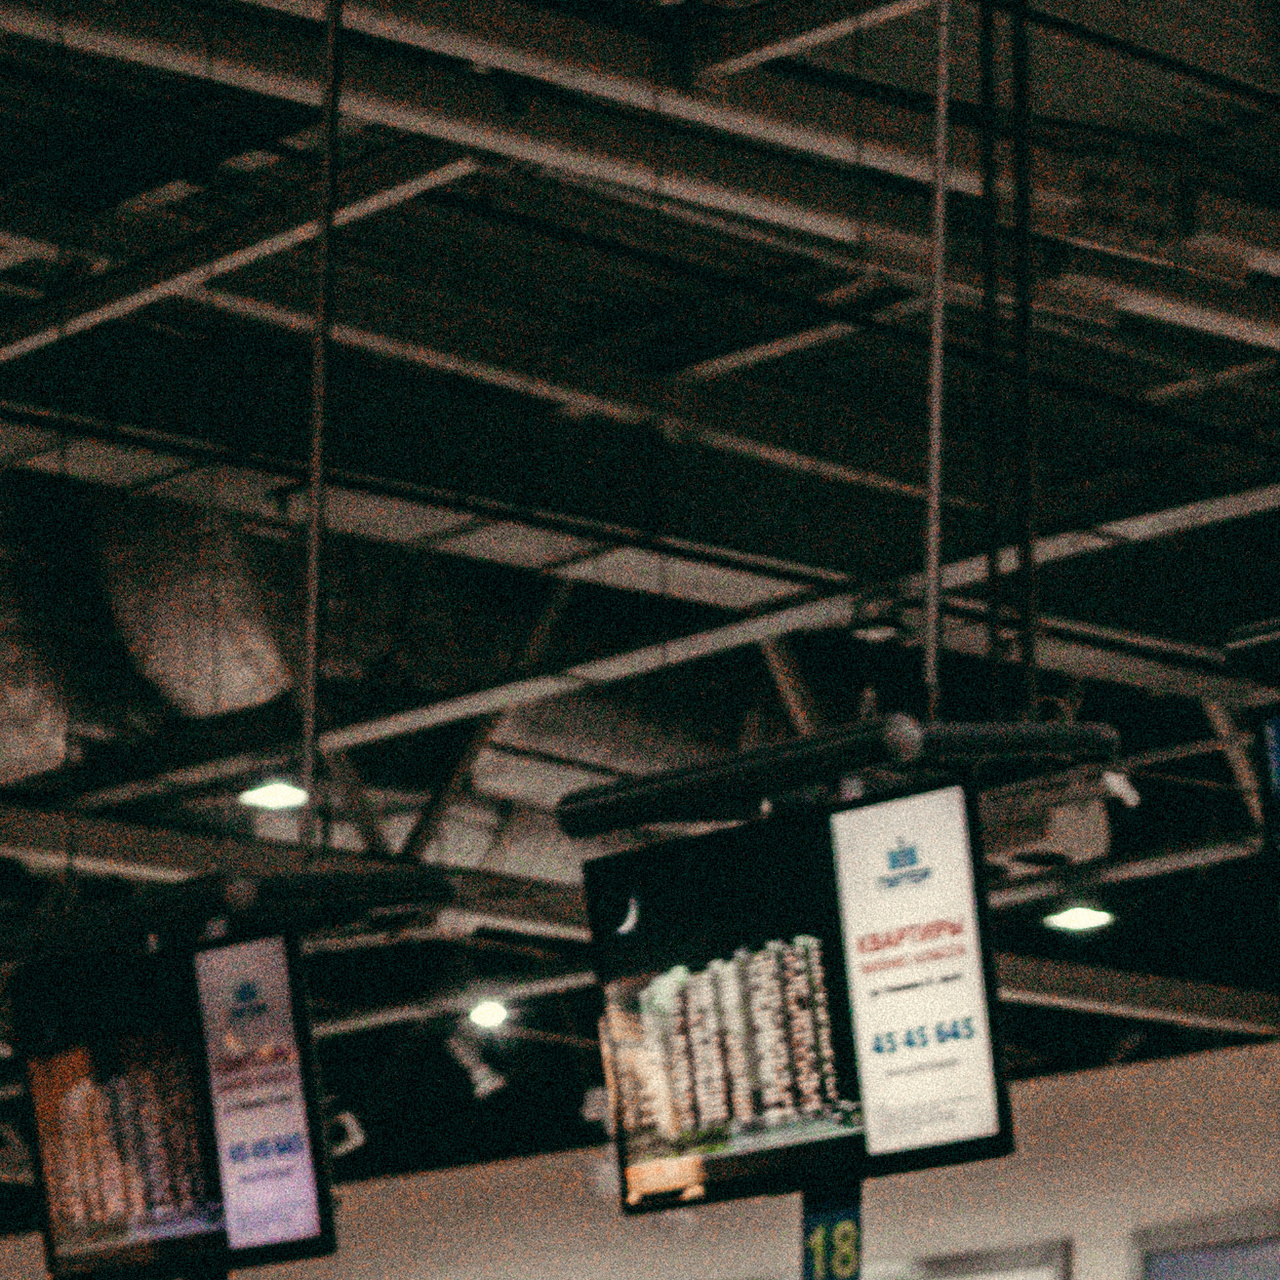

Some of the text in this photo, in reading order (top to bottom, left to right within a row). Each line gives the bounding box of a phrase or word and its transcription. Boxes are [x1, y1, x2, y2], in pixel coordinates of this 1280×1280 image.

[856, 917, 965, 957] КВАРТИРЫ
[871, 1016, 976, 1056] 45 45 645
[807, 1220, 857, 1280] 18
